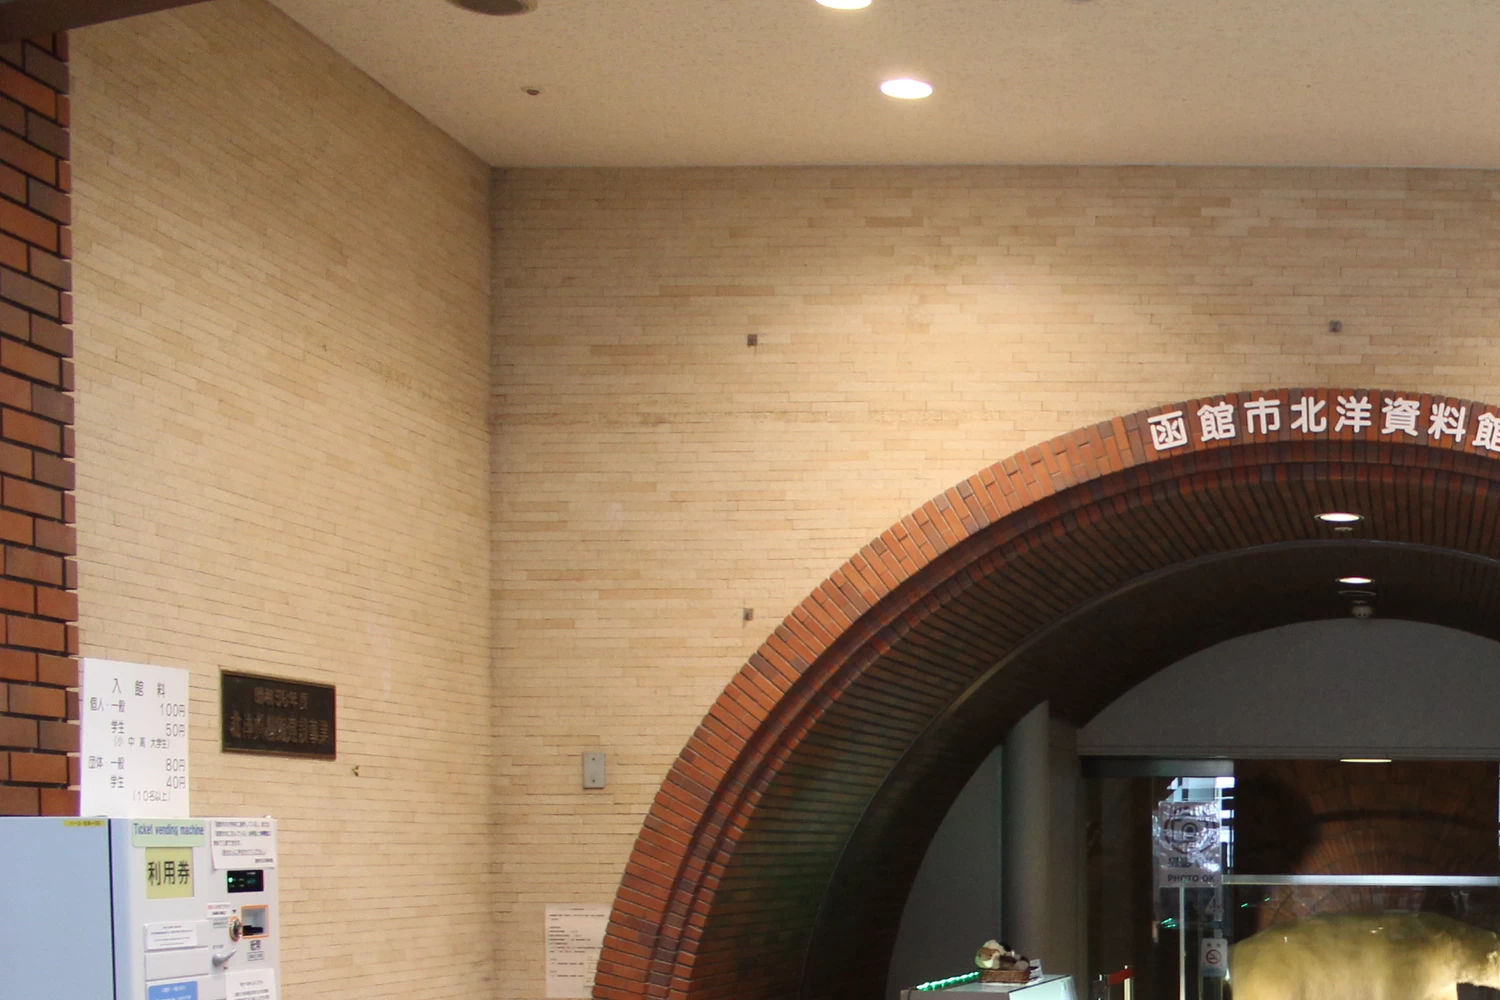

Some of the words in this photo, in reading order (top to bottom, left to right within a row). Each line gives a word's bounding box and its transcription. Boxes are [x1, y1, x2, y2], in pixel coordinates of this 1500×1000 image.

[133, 823, 153, 835] Ticket
[155, 823, 179, 836] vending
[180, 825, 204, 835] machine
[148, 860, 190, 886] 利用券
[1167, 874, 1199, 883] PHOTO
[1202, 874, 1215, 883] OK
